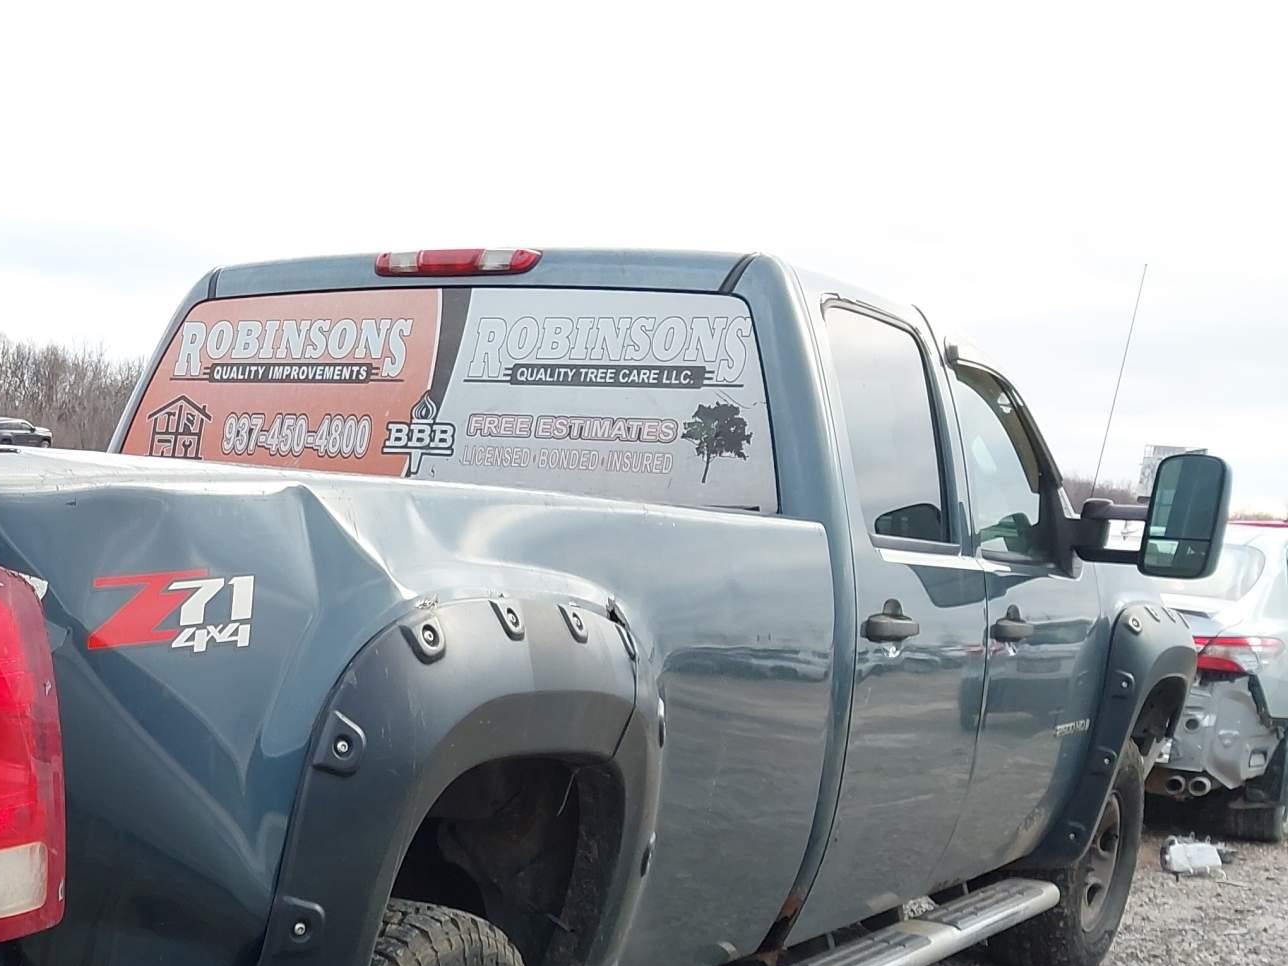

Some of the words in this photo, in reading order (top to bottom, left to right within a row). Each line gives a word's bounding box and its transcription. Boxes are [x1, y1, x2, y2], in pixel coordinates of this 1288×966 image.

[173, 318, 413, 377] ROBINSONS
[468, 316, 753, 383] ROBINSONS
[213, 365, 264, 380] QUALITY
[267, 366, 368, 381] IMPROVEMENTS
[516, 367, 575, 382] QUALITY
[579, 368, 615, 383] TREE
[618, 369, 660, 384] CARE
[663, 370, 695, 385] LLC.
[223, 413, 372, 457] 937-450-4800
[386, 423, 455, 449] BBB
[467, 413, 533, 437] FREE
[535, 416, 678, 443] ESTIMATES
[462, 446, 530, 467] LICENSED
[539, 448, 599, 470] BONDED
[605, 451, 673, 474] INSURED
[88, 568, 254, 649] Z71
